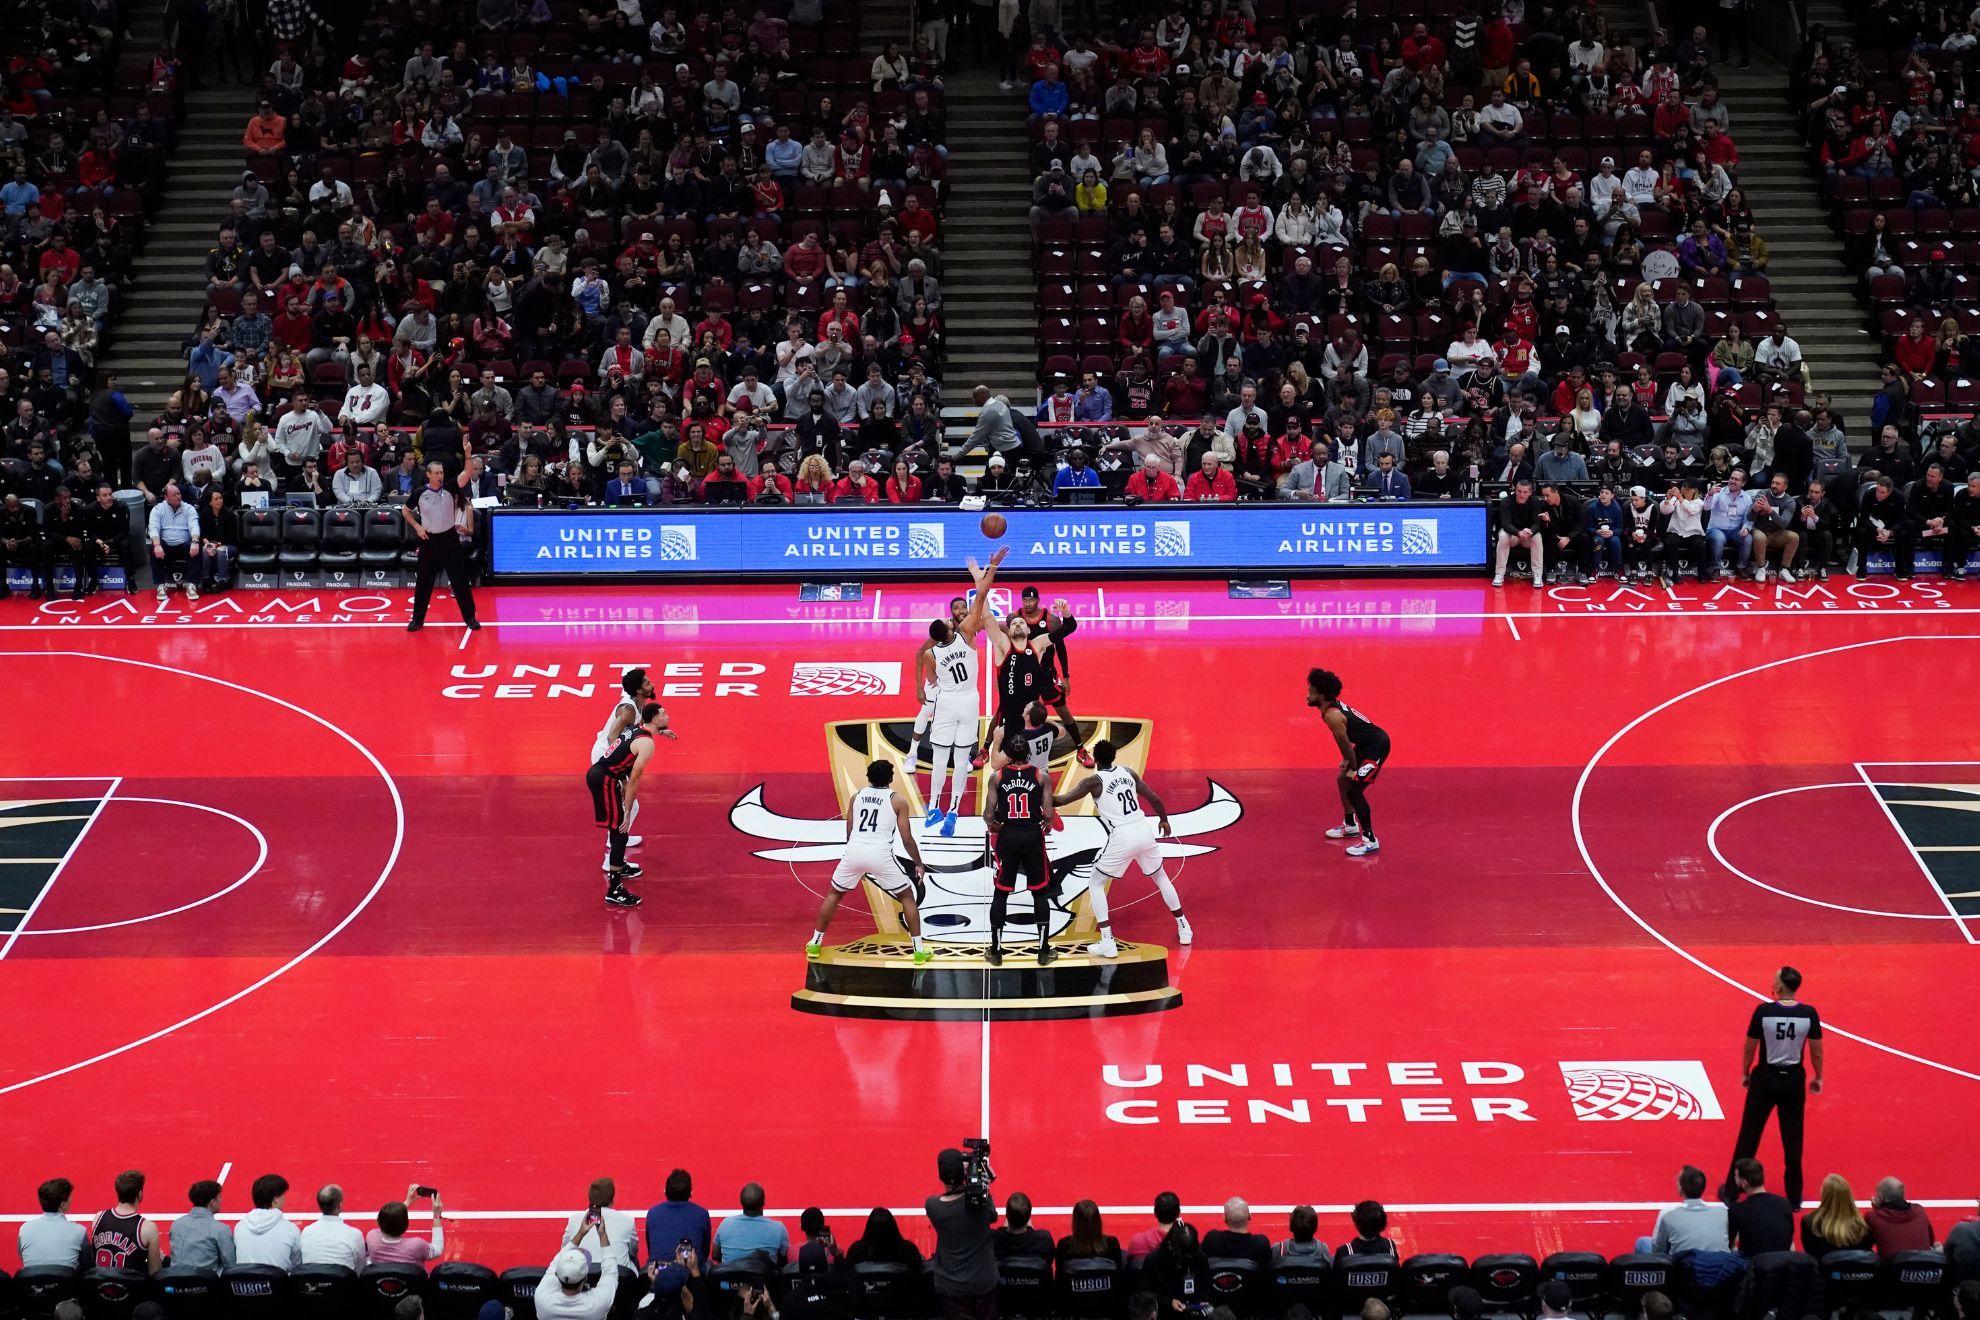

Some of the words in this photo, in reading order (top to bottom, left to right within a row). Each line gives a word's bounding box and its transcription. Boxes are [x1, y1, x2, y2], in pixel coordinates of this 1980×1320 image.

[1131, 400, 1147, 408] 23
[288, 421, 313, 435] Chicago
[606, 461, 615, 473] 5
[1345, 457, 1354, 468] 11
[561, 529, 651, 542] UNITED
[809, 527, 899, 540] UNITED
[1055, 525, 1145, 538] UNITED
[1302, 523, 1393, 536] UNITED
[537, 545, 651, 558] AIRLINES
[785, 543, 899, 556] AIRLINES
[1031, 541, 1145, 554] AIRLINES
[1278, 539, 1393, 552] AIRLINES
[1548, 582, 1943, 601] CALAMOS
[1558, 600, 1951, 612] INVESTMENTS
[31, 613, 414, 624] INVESTMENT
[940, 651, 967, 667] SIMMONS
[451, 663, 767, 678] UNITED
[949, 662, 969, 684] 10
[1008, 654, 1017, 695] CHICAGO
[1024, 673, 1032, 686] 9
[1035, 737, 1049, 755] 58
[1001, 778, 1036, 792] DeROZAN
[861, 796, 884, 806] THOMAS
[1007, 793, 1031, 819] 11
[1117, 789, 1138, 816] 28
[859, 808, 879, 832] 24
[1776, 1022, 1796, 1040] 54
[1102, 1062, 1525, 1088] UNITED
[1105, 1098, 1538, 1125] CENTER
[1079, 1279, 1104, 1290] USO
[1357, 1274, 1380, 1285] USO
[1633, 1272, 1659, 1284] USO
